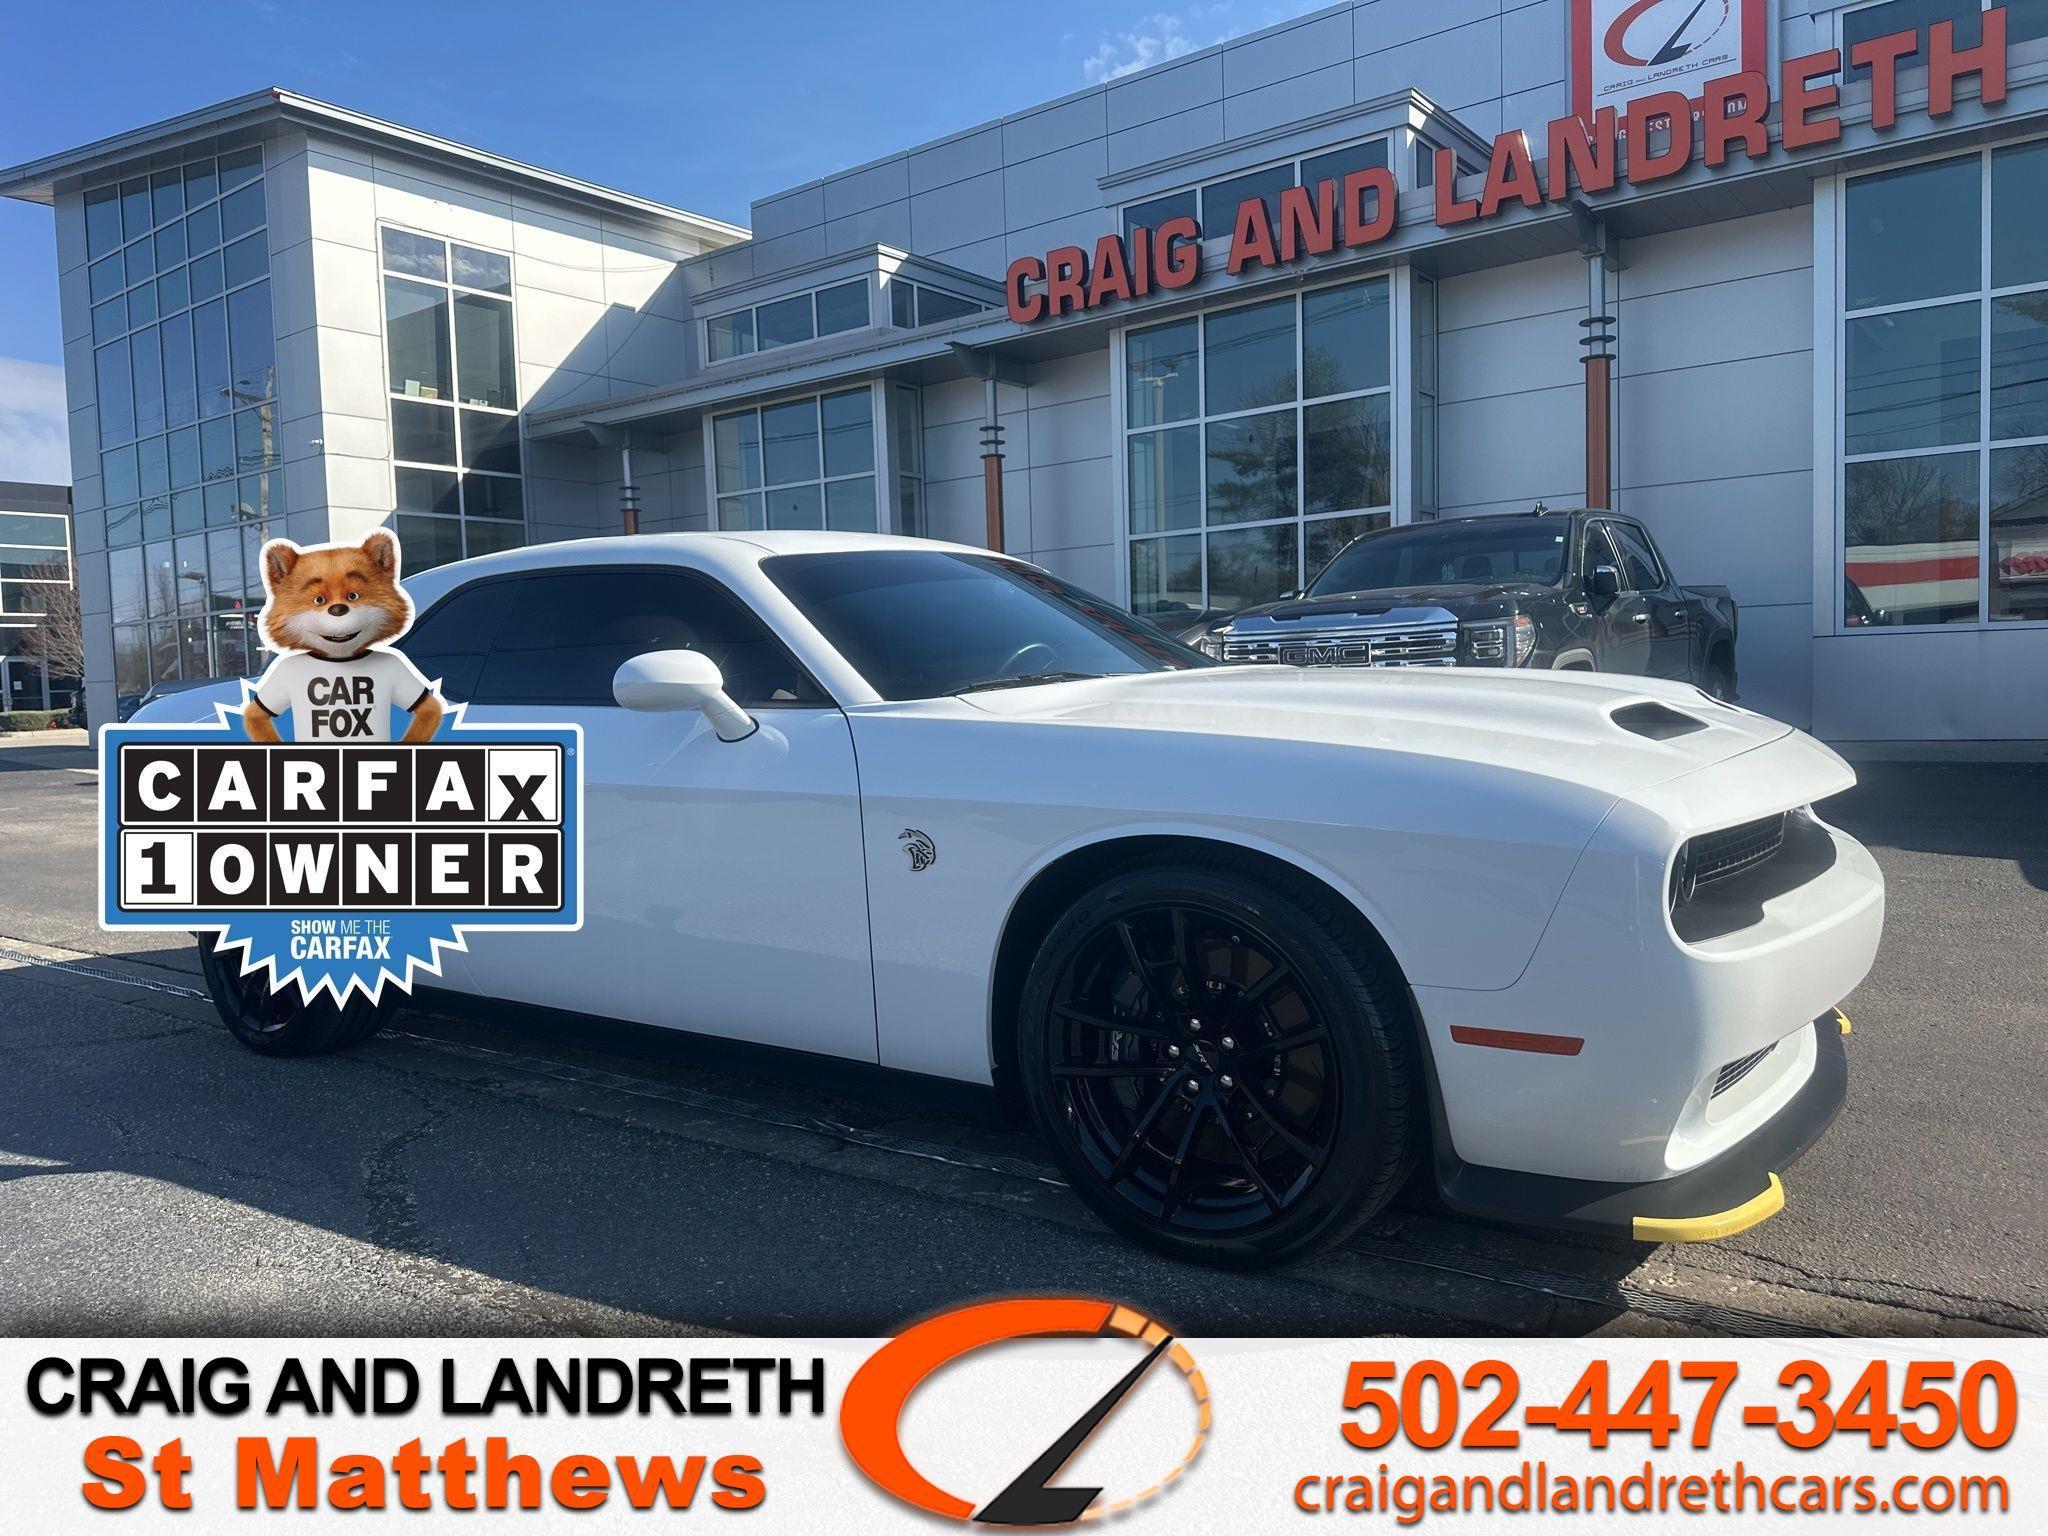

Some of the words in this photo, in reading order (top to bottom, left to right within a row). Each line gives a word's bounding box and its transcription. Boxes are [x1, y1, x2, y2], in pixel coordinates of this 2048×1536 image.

[1603, 79, 1633, 92] CRAIG
[1647, 62, 1698, 80] LANDRETH
[1701, 54, 1729, 66] CARS
[1005, 215, 1202, 325] CRAIG
[1226, 166, 1400, 276] AND
[1435, 6, 2008, 229] LANDRETH
[1282, 646, 1366, 664] GMC
